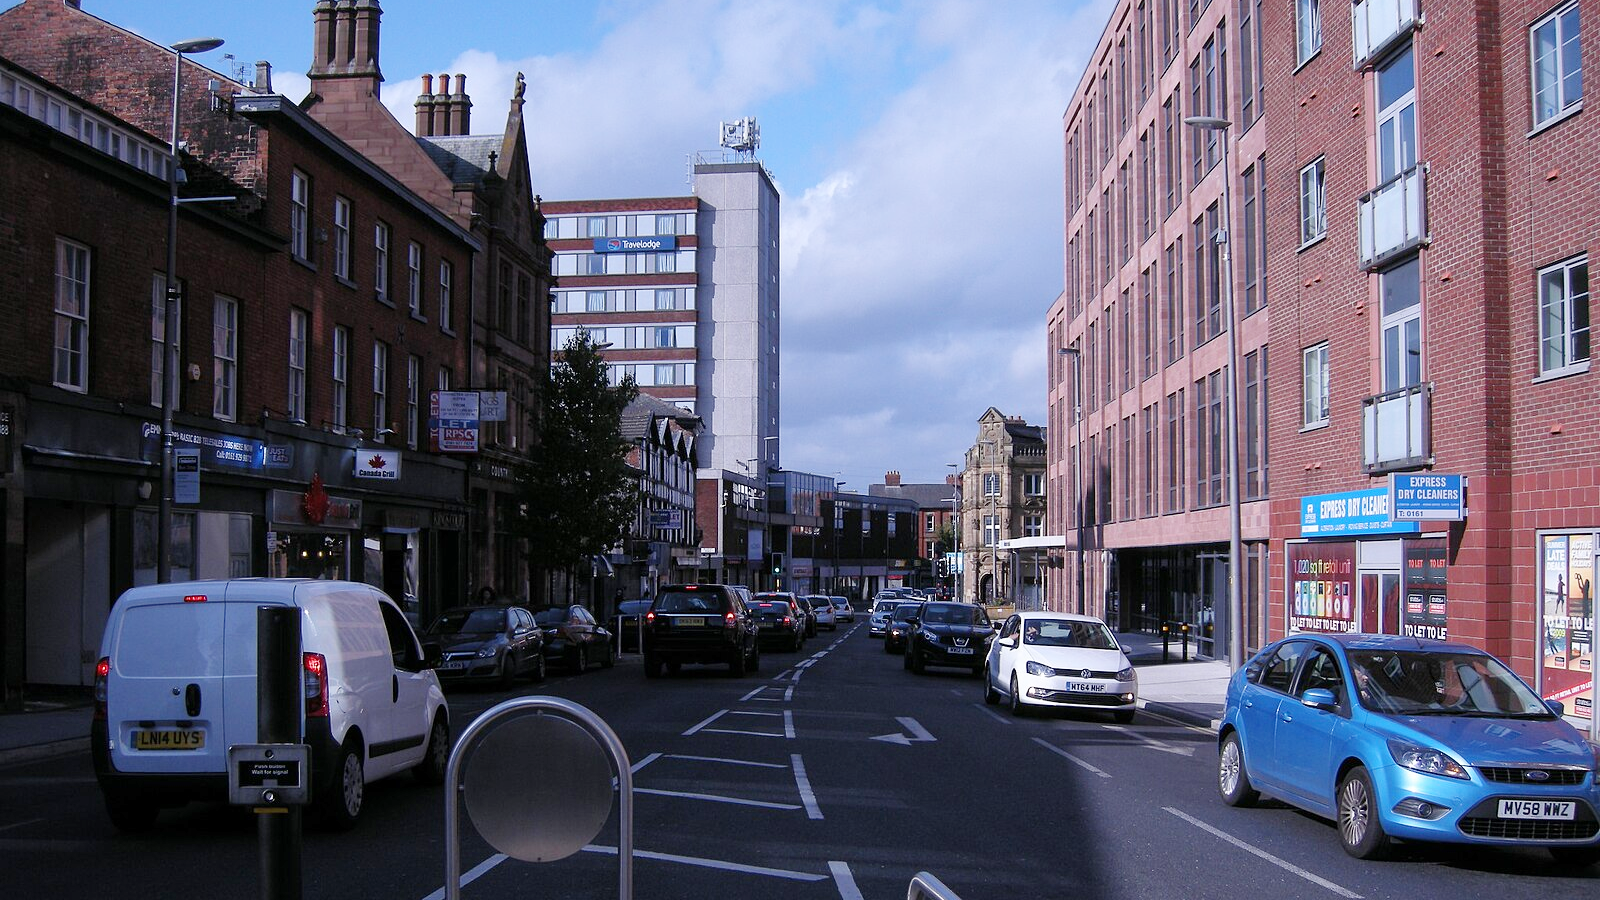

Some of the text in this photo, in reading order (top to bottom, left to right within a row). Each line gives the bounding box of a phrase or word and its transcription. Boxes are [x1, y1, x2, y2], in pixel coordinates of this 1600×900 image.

[622, 239, 661, 249] Travelodge
[439, 420, 471, 428] LET
[359, 469, 395, 478] Canada Grill
[1410, 477, 1446, 487] EXPRESS
[1398, 489, 1458, 499] DRY CLEANERS
[1320, 499, 1346, 519] EXPRESS
[1347, 497, 1361, 517] DRY
[1547, 549, 1565, 561] LATE
[1571, 550, 1592, 560] FAMILY
[1310, 562, 1318, 577] sq
[1340, 559, 1351, 574] unit
[1408, 560, 1423, 568] TO LET
[1430, 559, 1445, 568] TO LET
[1547, 561, 1565, 570] DEALS
[1291, 617, 1296, 626] TO
[1297, 618, 1305, 628] LET
[1306, 618, 1312, 628] TO
[1313, 618, 1322, 629] LET
[1323, 619, 1329, 630] TO
[1330, 620, 1339, 631] LET
[1340, 621, 1347, 632] TO
[1543, 615, 1554, 627] TO
[1554, 616, 1570, 629] LET
[1571, 617, 1582, 629] TO
[1405, 624, 1413, 637] TO
[1414, 625, 1426, 638] LET
[1426, 625, 1436, 639] TO
[1071, 683, 1105, 692] MT64 MHF
[141, 731, 199, 745] LN14 UYS
[1504, 801, 1569, 817] MV58 WWZ
